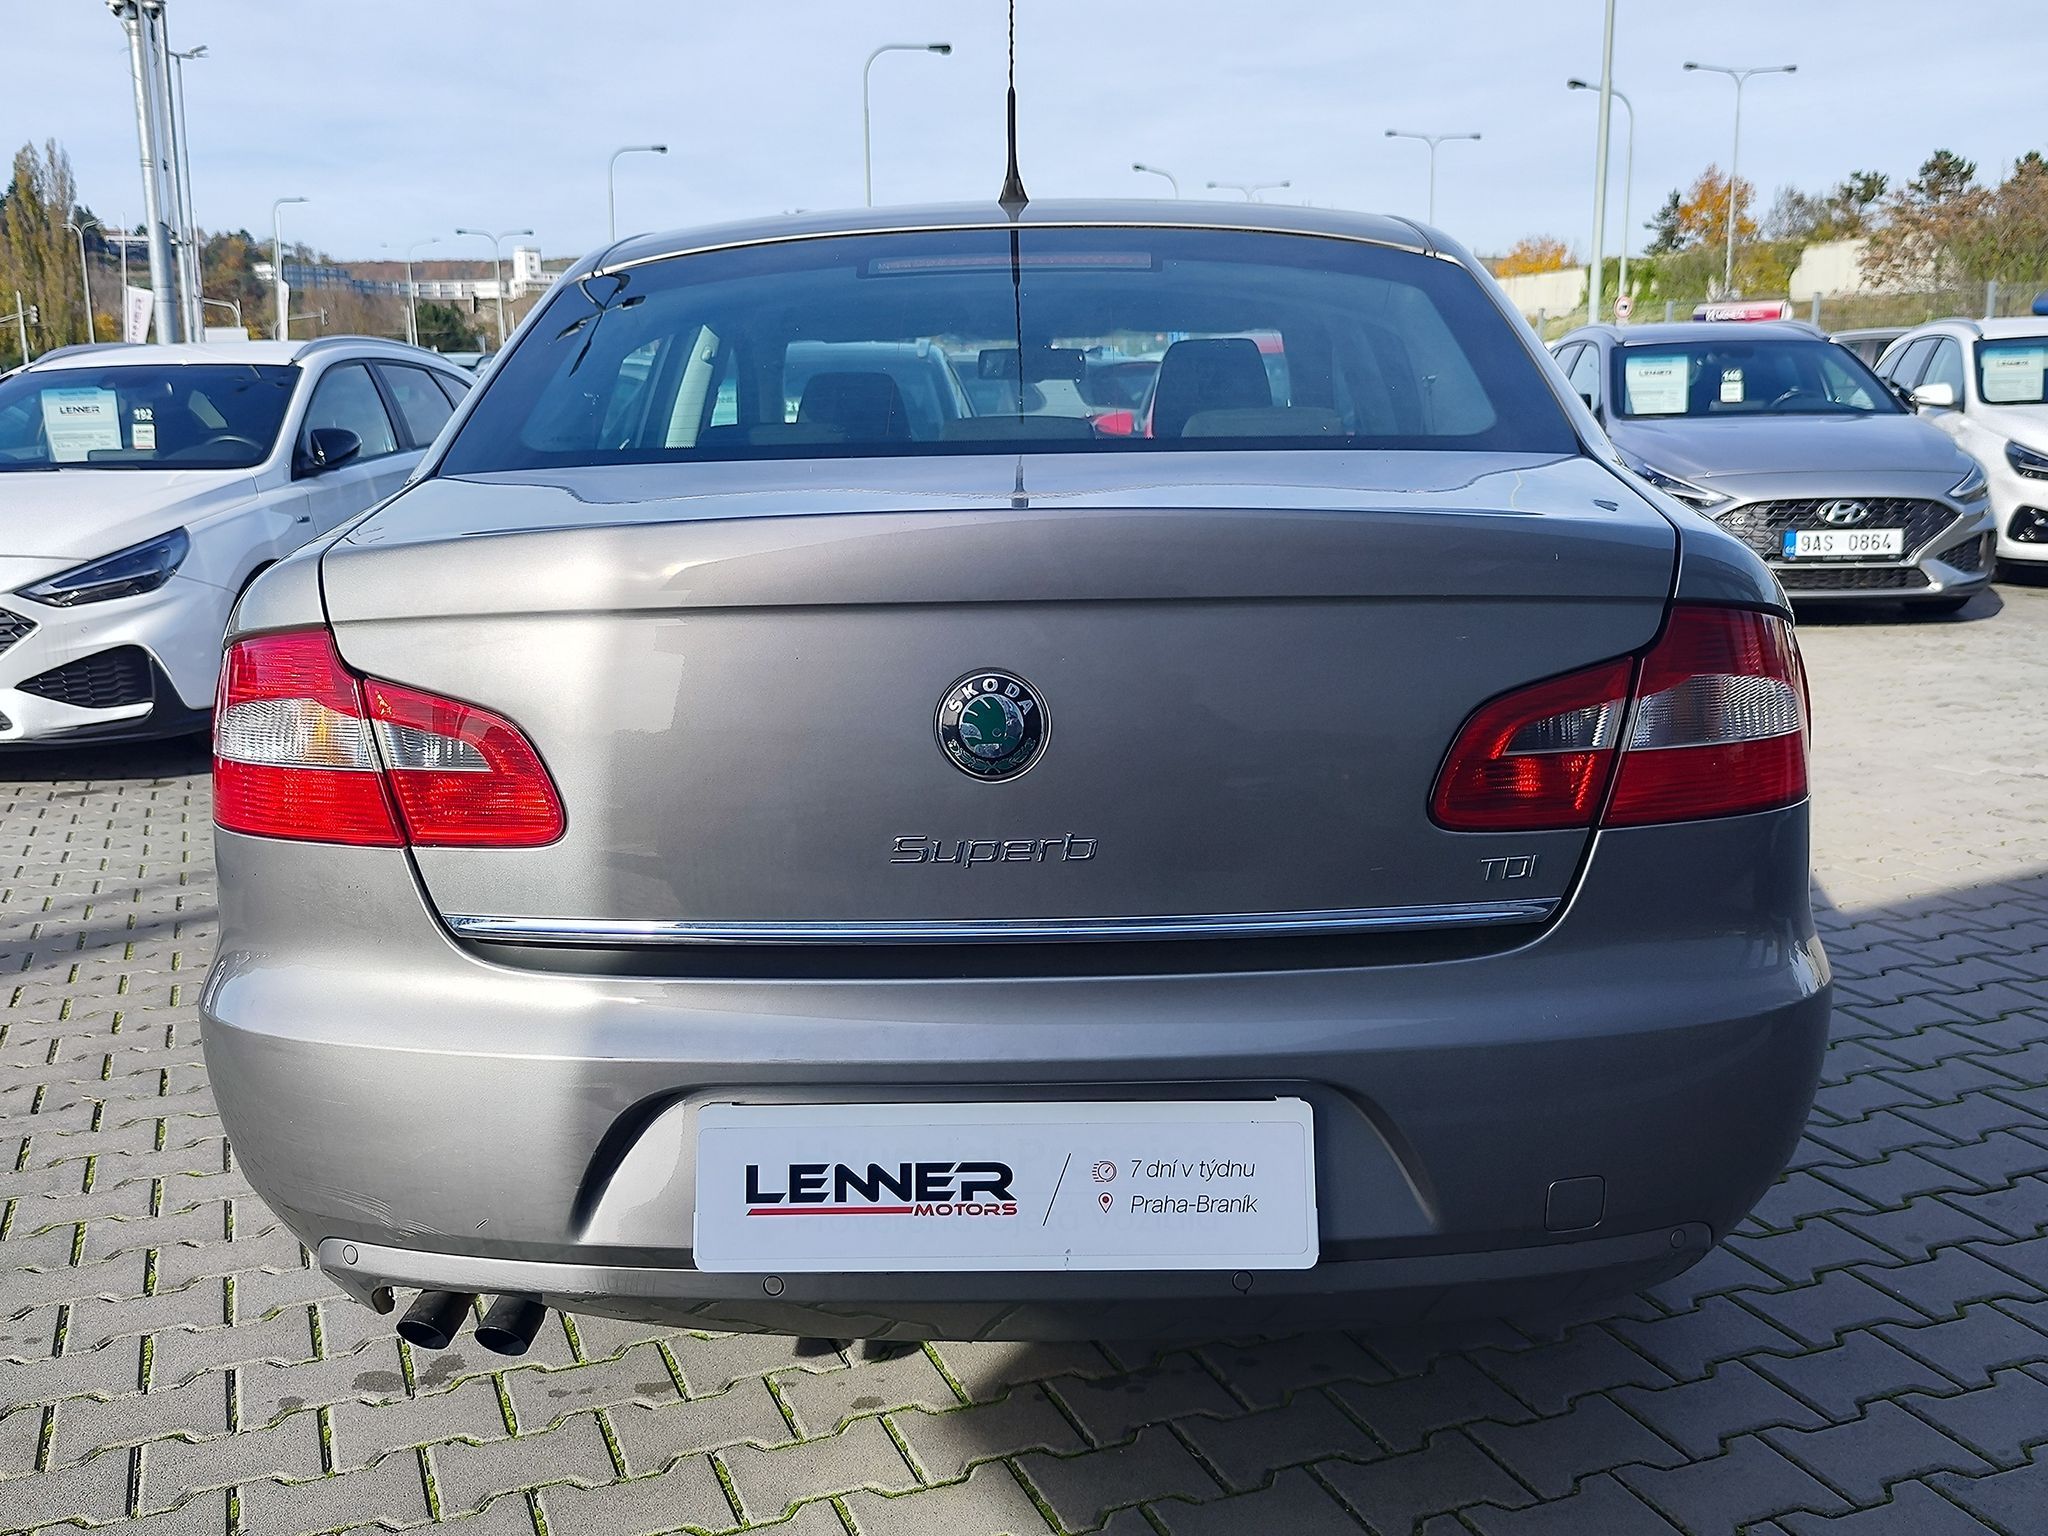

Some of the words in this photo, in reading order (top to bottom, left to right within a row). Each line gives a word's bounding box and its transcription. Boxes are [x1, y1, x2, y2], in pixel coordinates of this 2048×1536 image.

[59, 405, 101, 415] LENNER
[1801, 535, 1833, 552] 9AS
[1848, 533, 1892, 551] 0864
[889, 831, 1099, 868] Superb
[1480, 853, 1538, 881] TDI
[1131, 1159, 1143, 1178] 7
[1146, 1159, 1179, 1178] dní
[1181, 1163, 1195, 1178] v
[1199, 1158, 1256, 1182] týdnu
[745, 1161, 1018, 1204] LENNER
[913, 1203, 1018, 1217] MOTORS
[1130, 1194, 1259, 1214] Praha-Braník
